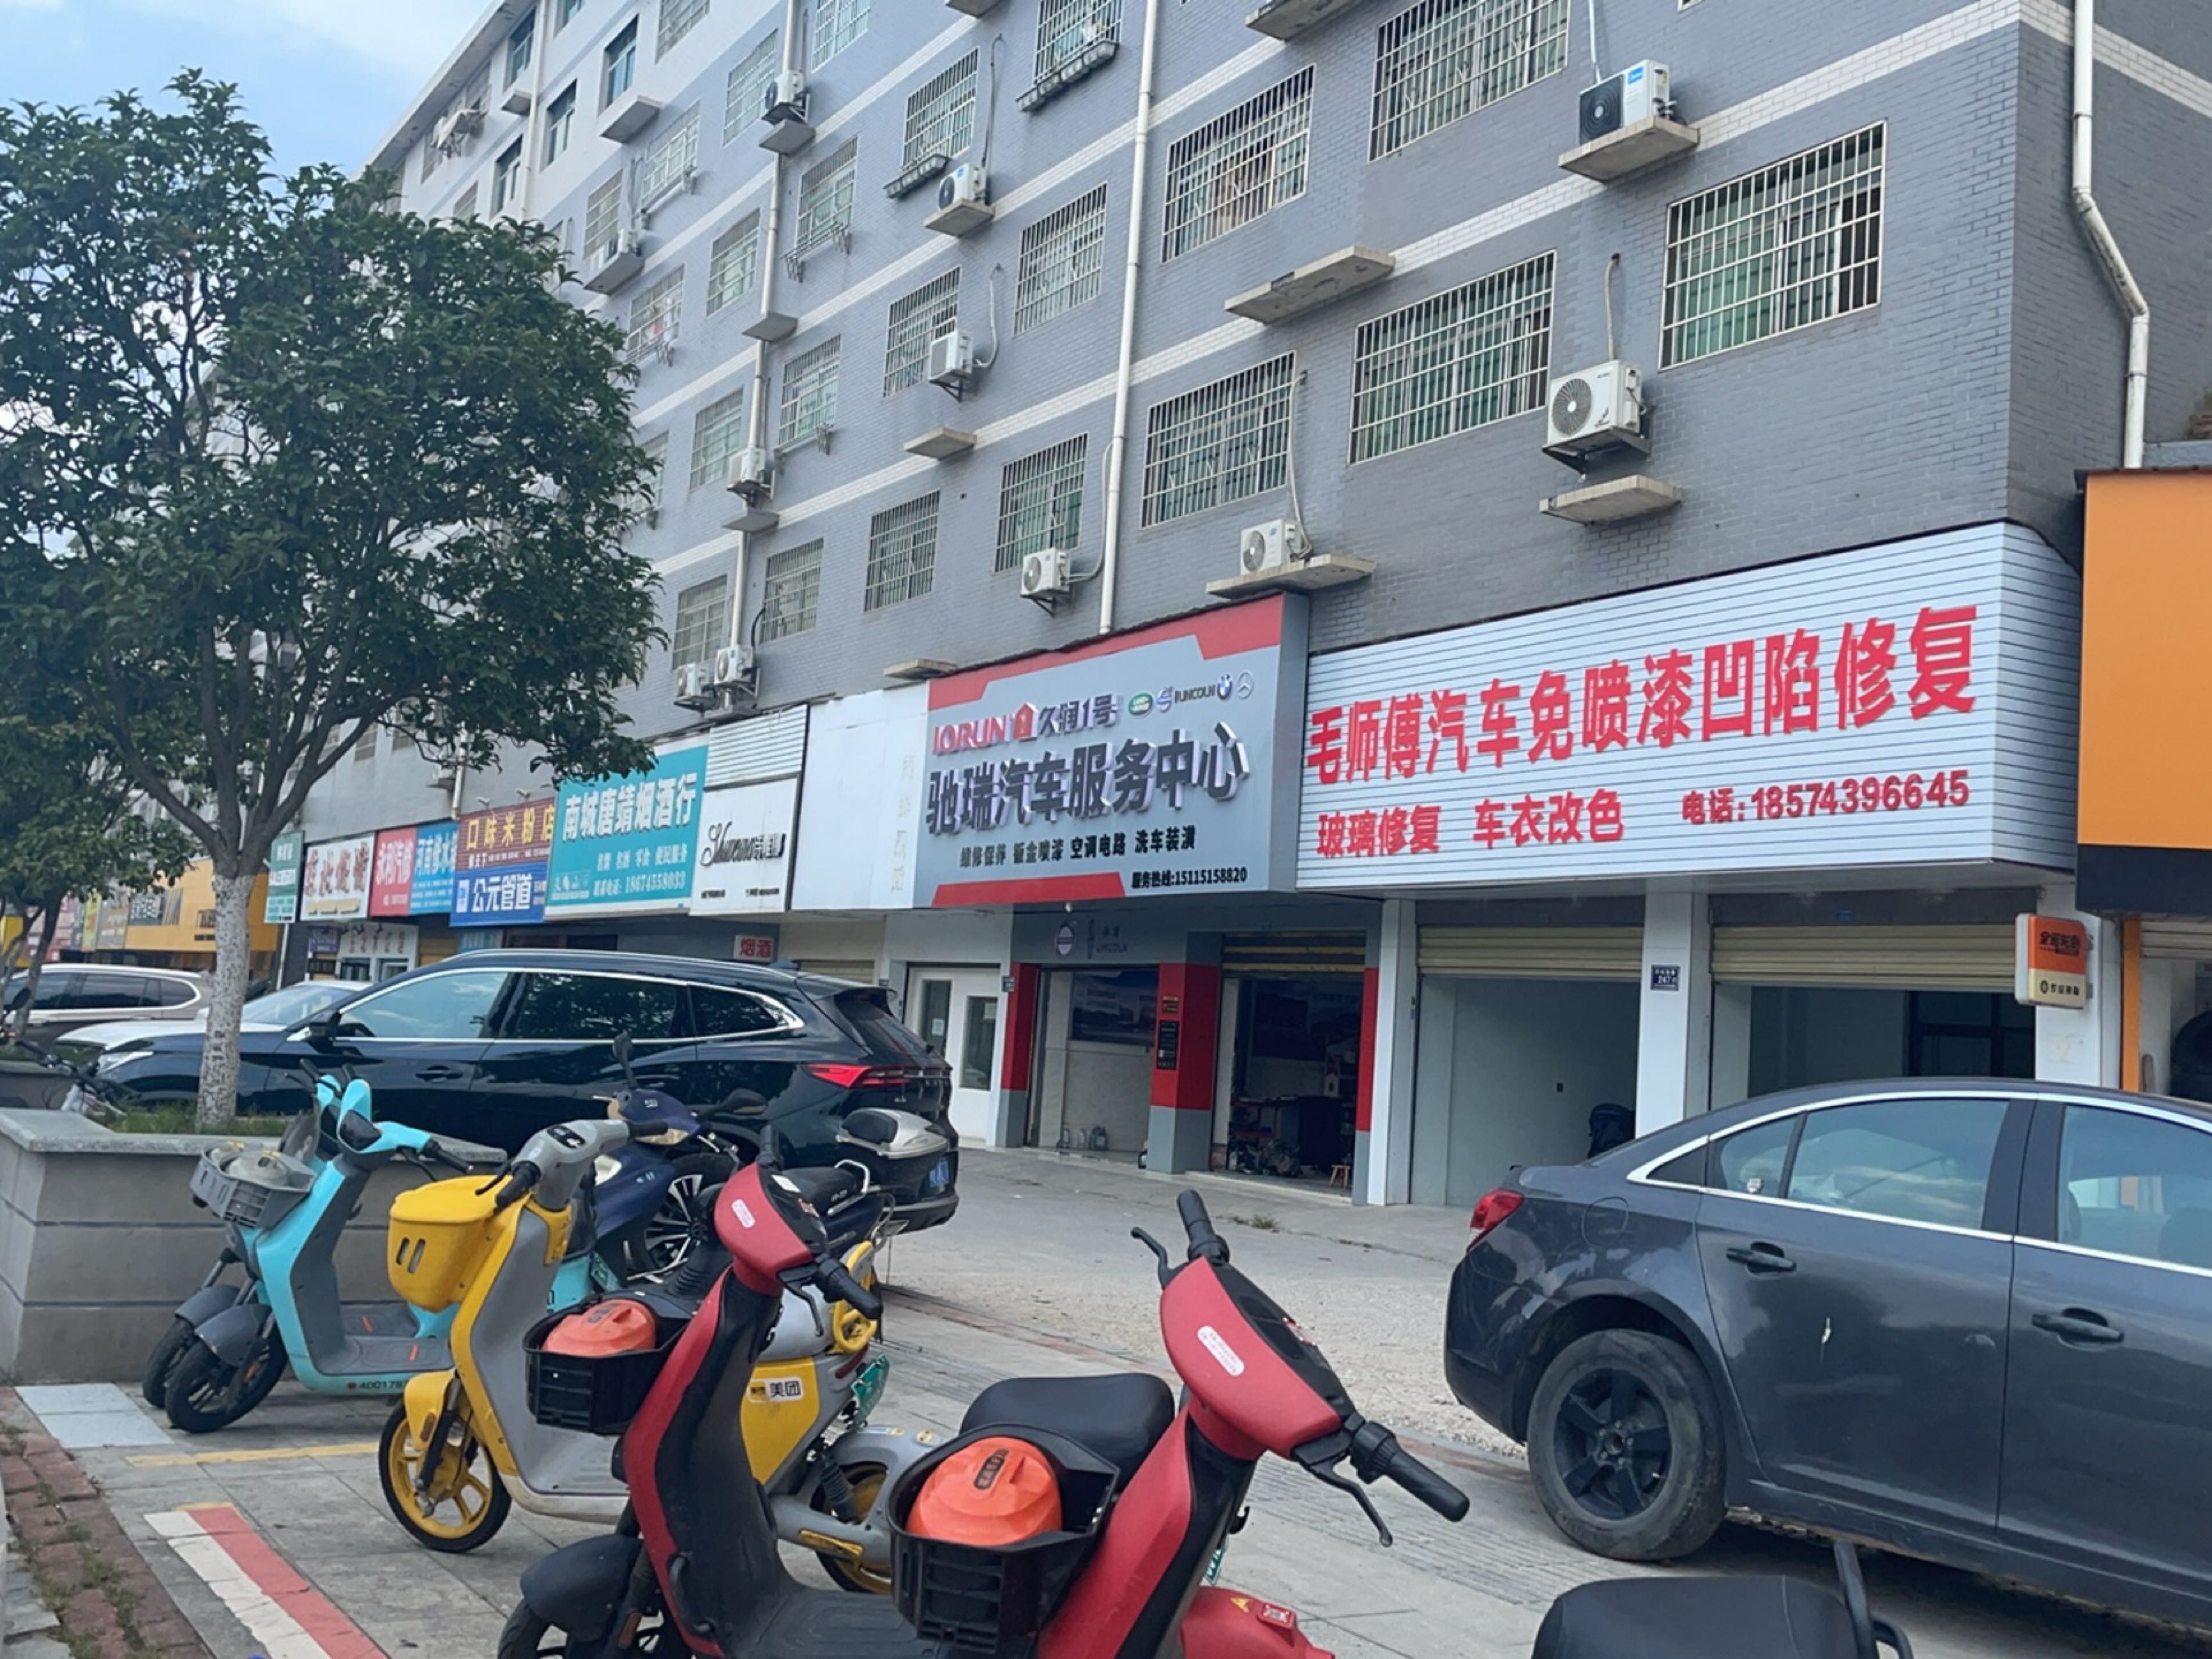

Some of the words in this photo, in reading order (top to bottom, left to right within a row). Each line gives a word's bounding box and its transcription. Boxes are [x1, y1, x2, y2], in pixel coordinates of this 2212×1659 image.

[1306, 604, 1977, 785] 毛师傅汽车免喷漆凹陷修复
[926, 721, 1249, 834] 驰瑞汽车服务中心
[1070, 832, 1126, 860] 空调电路
[1316, 805, 1442, 858] 玻璃修复
[1473, 788, 1625, 850] 车衣改色
[471, 872, 533, 913] 公元管道
[769, 1381, 801, 1398] 美团
